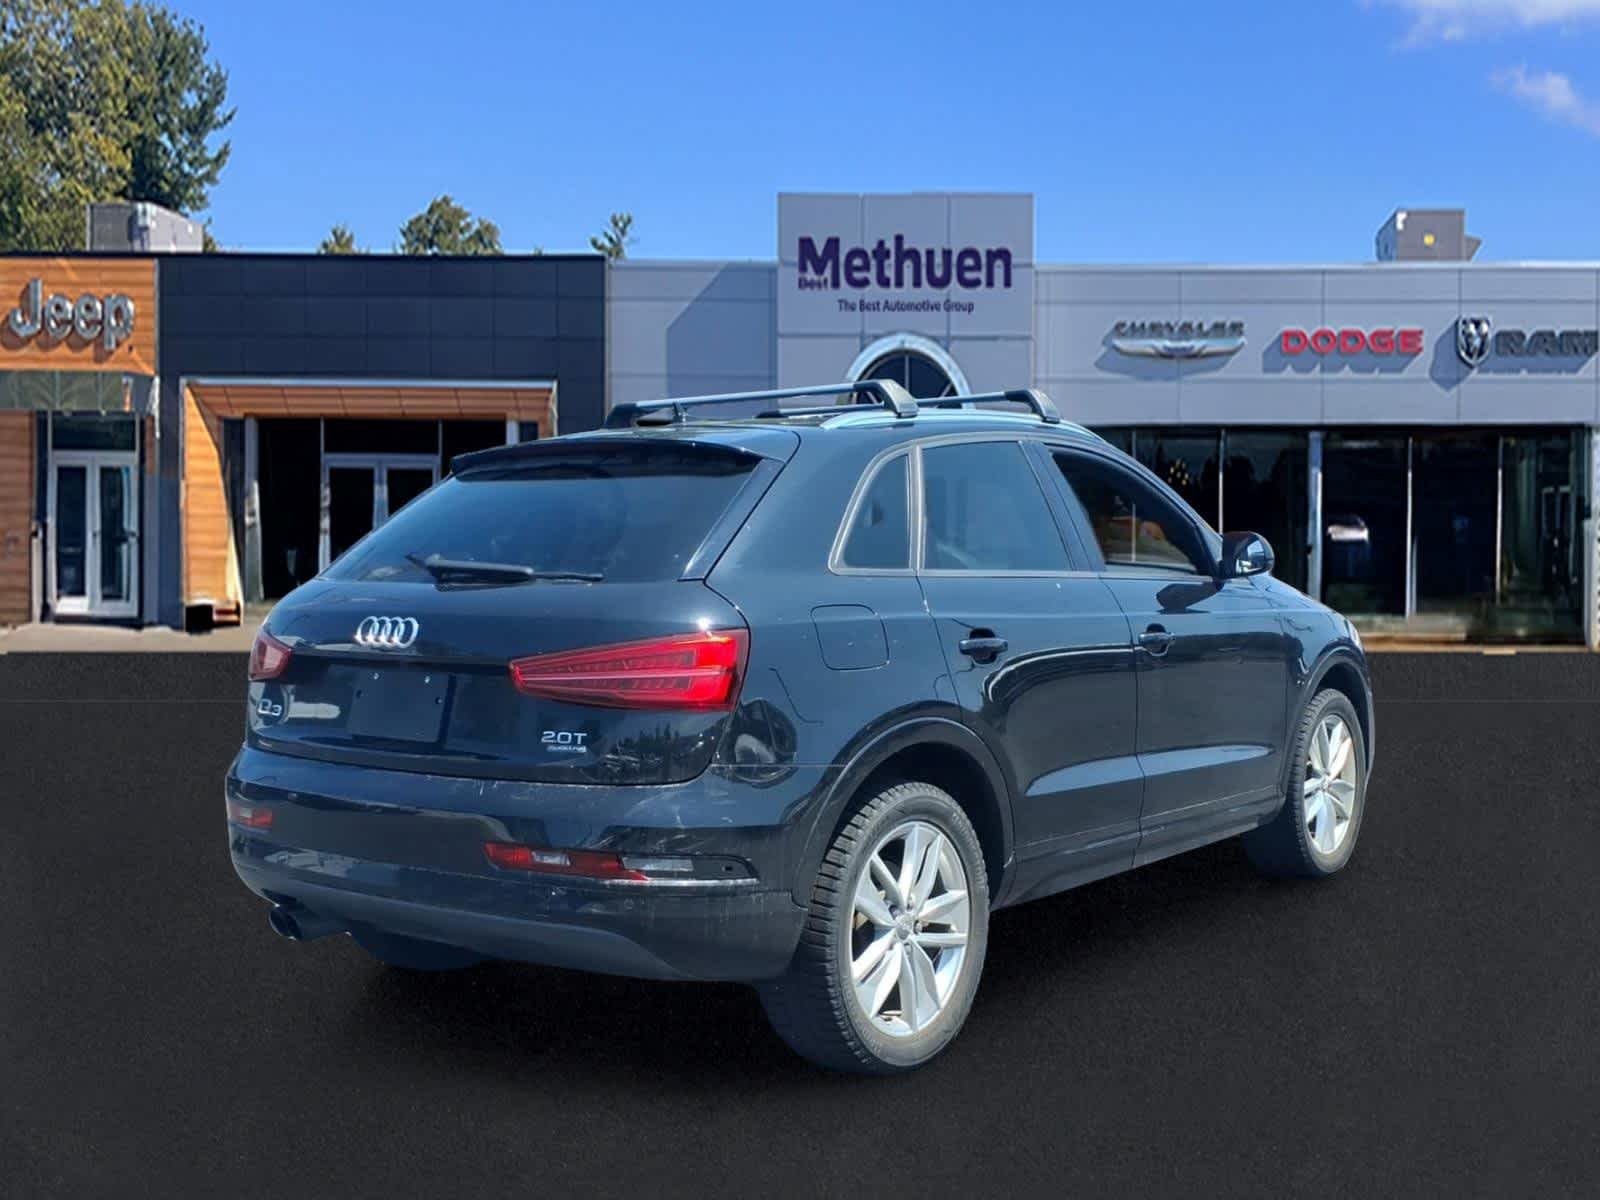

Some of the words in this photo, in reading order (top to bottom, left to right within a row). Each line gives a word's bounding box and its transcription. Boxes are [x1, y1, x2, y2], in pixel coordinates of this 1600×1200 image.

[798, 234, 1012, 289] Methuen
[9, 278, 134, 350] Jeep
[838, 299, 857, 312] The
[859, 299, 880, 312] Best
[882, 299, 941, 312] Automotive
[943, 299, 975, 314] Group
[1113, 320, 1244, 339] CHRYSLER
[1281, 328, 1424, 353] DODGE
[1494, 330, 1598, 357] RAM
[258, 698, 282, 716] Q3
